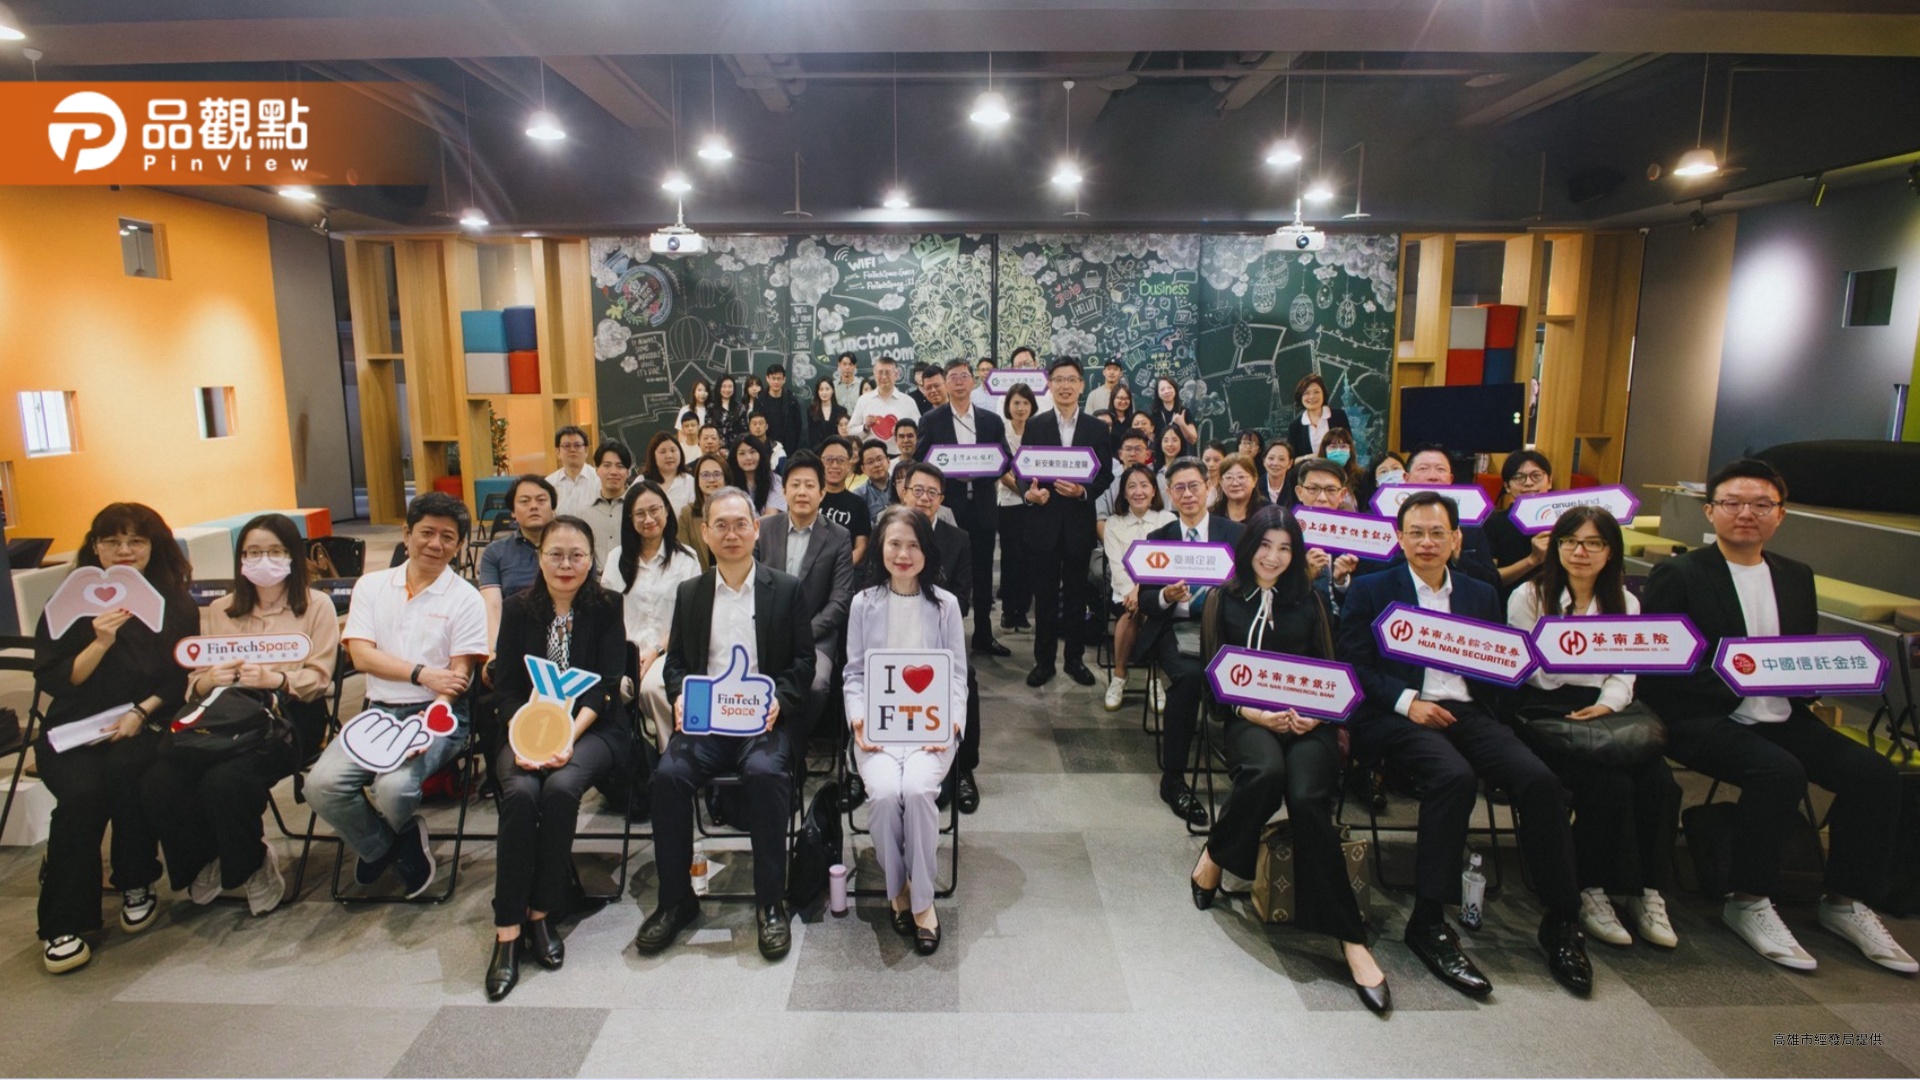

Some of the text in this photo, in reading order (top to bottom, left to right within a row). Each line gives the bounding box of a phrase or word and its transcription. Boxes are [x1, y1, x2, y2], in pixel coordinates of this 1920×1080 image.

[847, 257, 876, 271] WIFI
[1140, 279, 1190, 296] Business
[823, 326, 899, 355] Function
[207, 640, 299, 654] FinTechSpace
[1419, 626, 1520, 657] 華南永昌綜合證券
[1592, 632, 1669, 646] 華南產險
[1418, 638, 1517, 668] HUA NAN SECURITIES
[1761, 656, 1868, 671] 中國信託金控
[884, 665, 896, 694] I
[1258, 669, 1337, 691] 華南商業銀行
[717, 693, 760, 705] FinTech
[1319, 691, 1335, 699] BANK
[721, 705, 756, 717] Space
[878, 705, 941, 732] FTS
